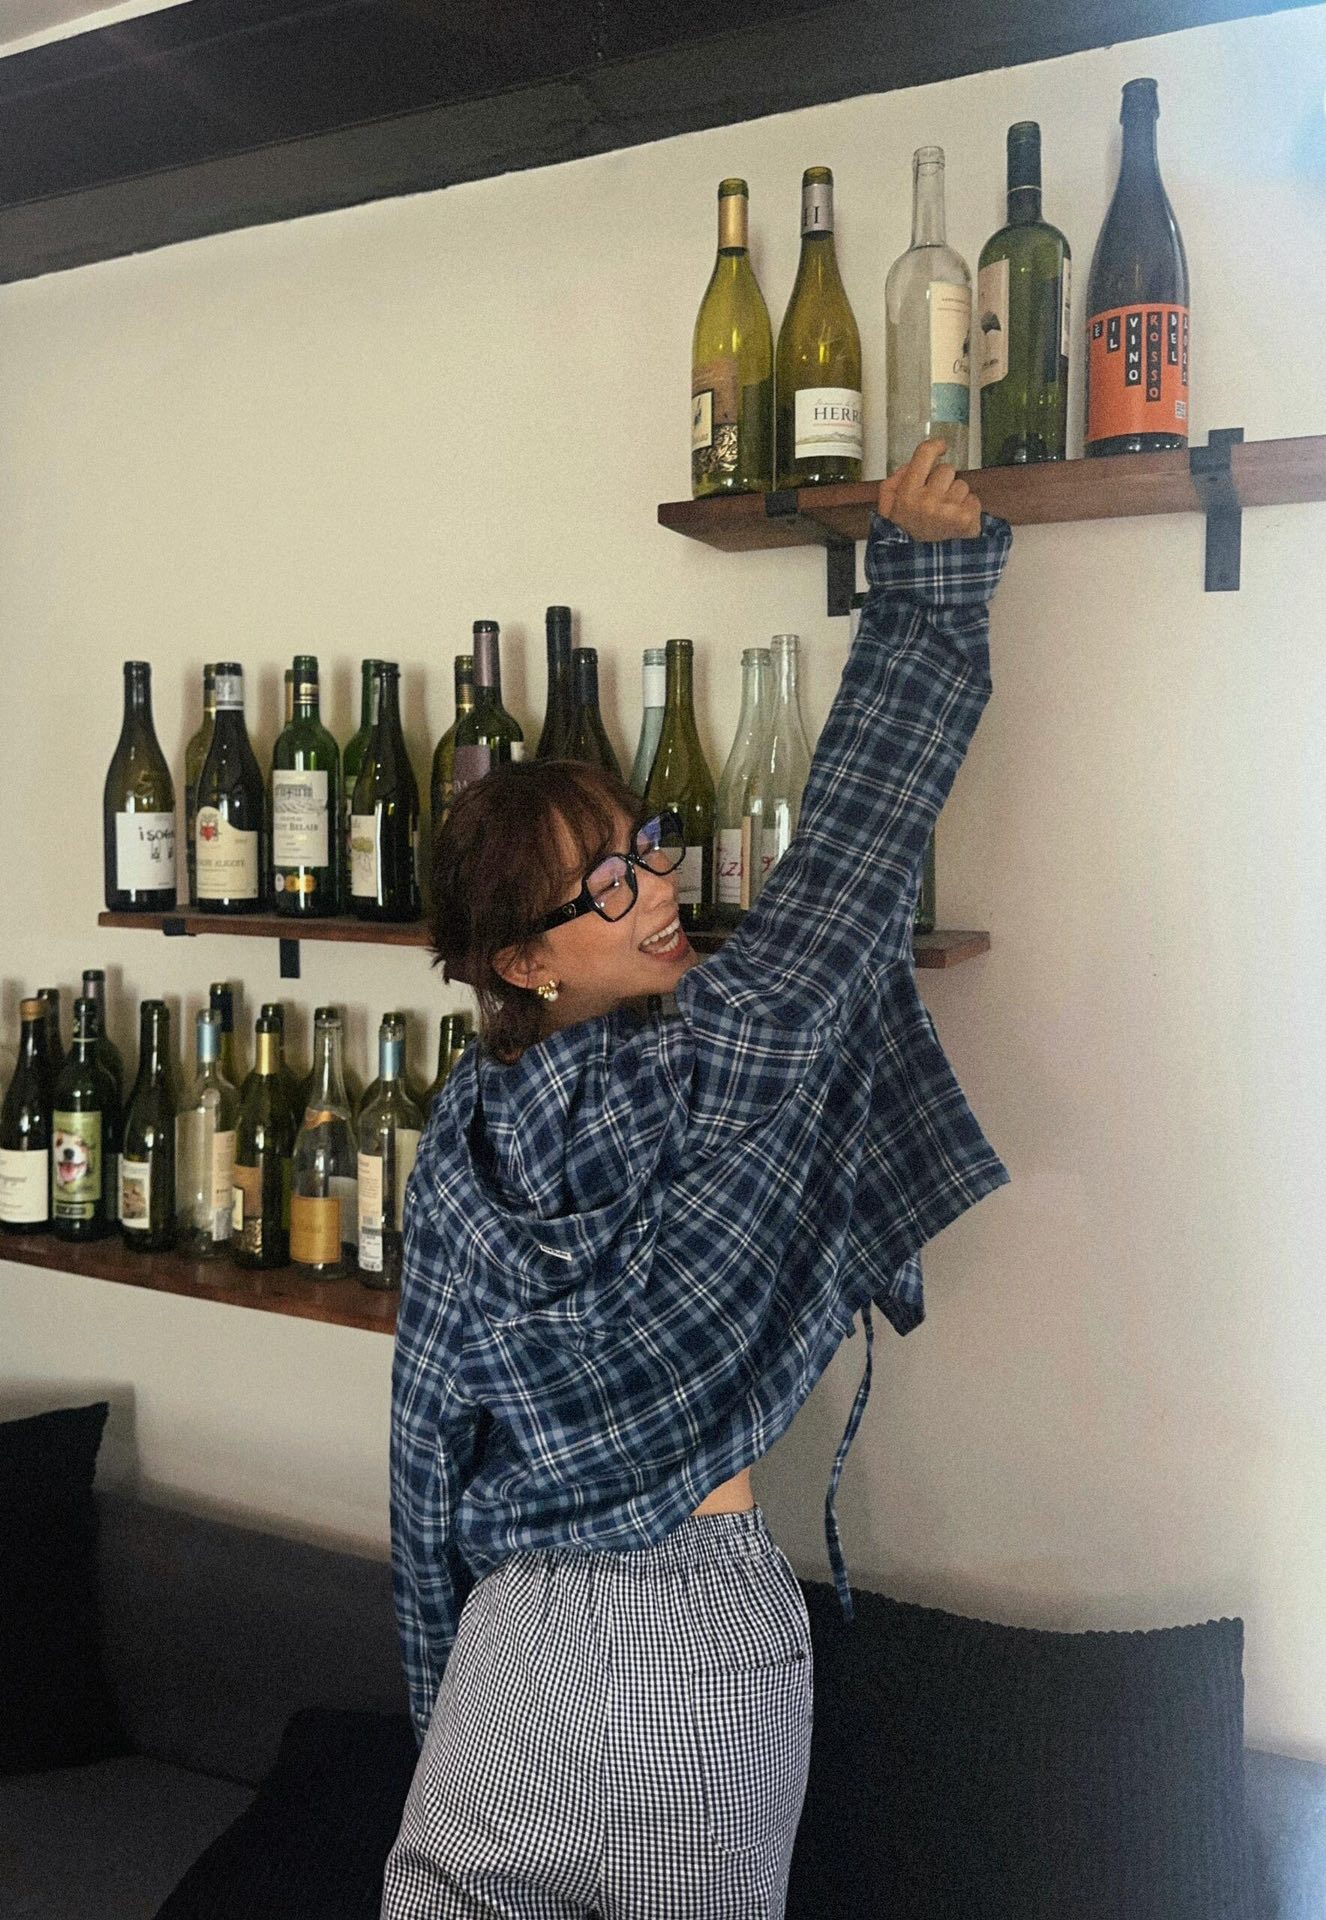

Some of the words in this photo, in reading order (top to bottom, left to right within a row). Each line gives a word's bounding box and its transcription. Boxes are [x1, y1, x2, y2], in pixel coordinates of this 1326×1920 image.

[1108, 320, 1119, 350] IL
[1127, 315, 1140, 382] VINO
[1148, 314, 1160, 398] ROSSO
[1169, 313, 1178, 363] DEL
